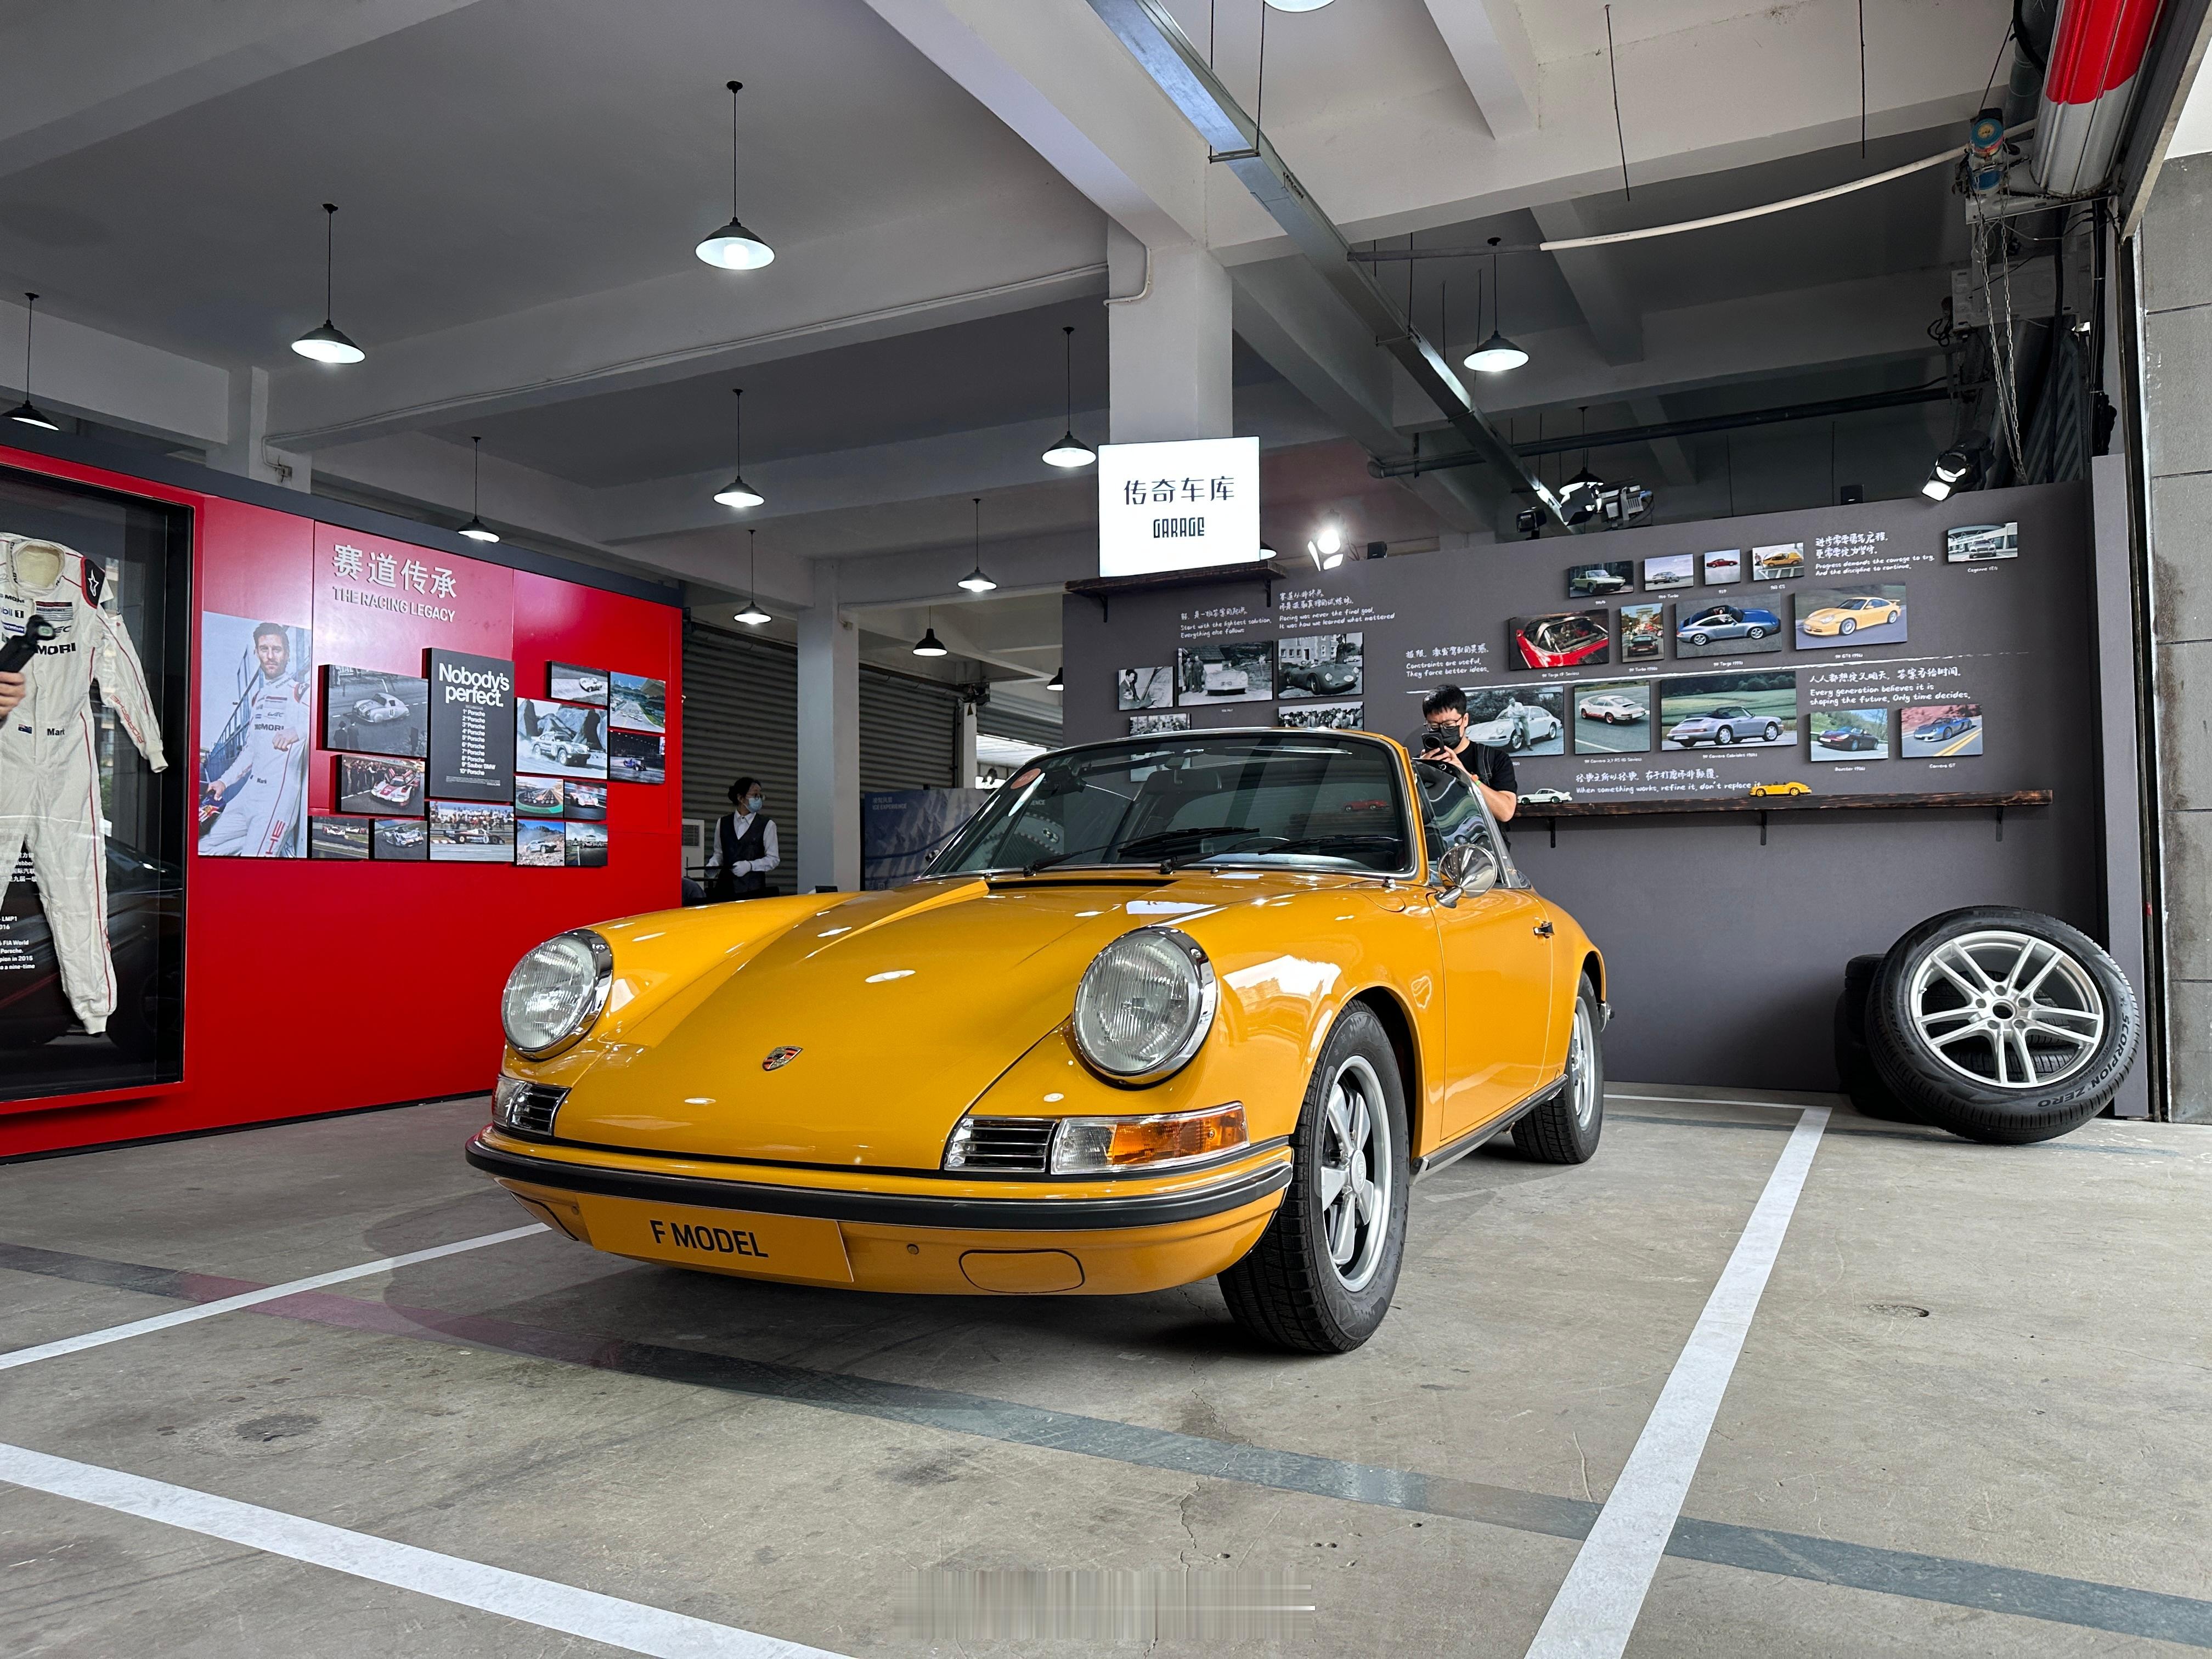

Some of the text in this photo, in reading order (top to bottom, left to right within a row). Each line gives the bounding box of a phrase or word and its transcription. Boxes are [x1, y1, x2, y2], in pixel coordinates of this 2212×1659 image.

[1124, 476, 1234, 505] 传奇车库
[1153, 517, 1205, 538] GARAGE
[332, 544, 457, 599] 赛道传承
[332, 586, 456, 623] THE RACING LEGACY
[1224, 620, 1246, 628] lightest
[1364, 613, 1395, 621] mattered
[36, 642, 76, 655] MORI
[1406, 661, 1443, 669] Constraints
[439, 663, 510, 692] Nobody's
[1810, 689, 1833, 697] Every
[1836, 686, 1879, 697] generation
[1810, 697, 1838, 707] shaping
[1893, 694, 1910, 703] Only
[1935, 691, 1971, 699] decides.
[1597, 785, 1634, 794] something
[1700, 781, 1722, 790] don't
[1724, 782, 1751, 791] replace
[2037, 1012, 2130, 1107] SCORPION ZERO
[650, 1220, 769, 1258] F MODEL
